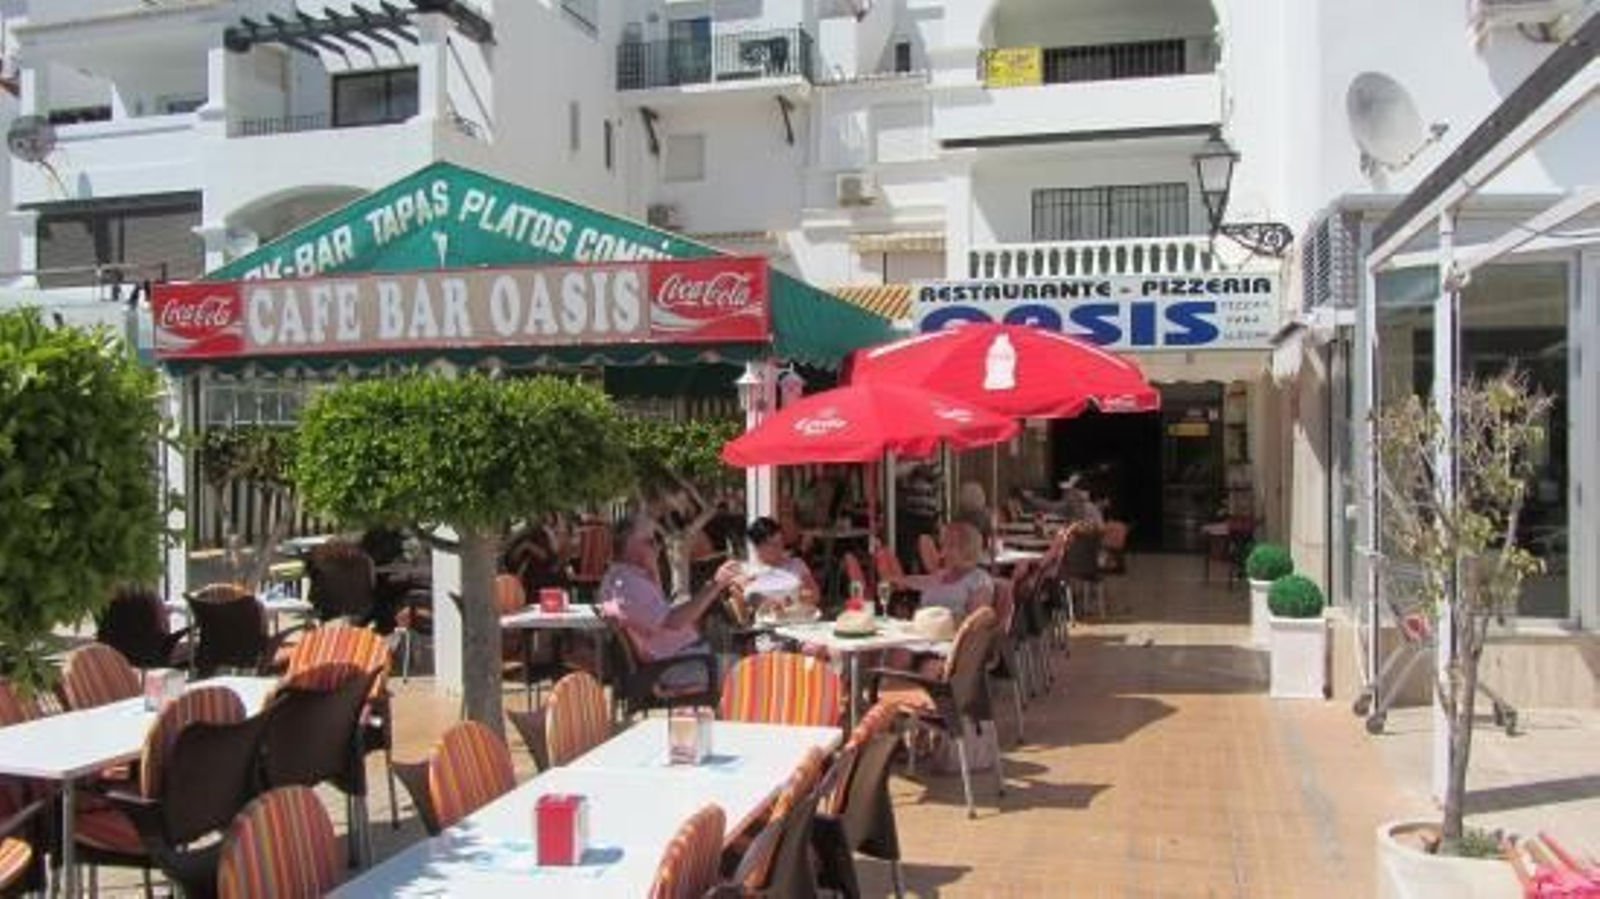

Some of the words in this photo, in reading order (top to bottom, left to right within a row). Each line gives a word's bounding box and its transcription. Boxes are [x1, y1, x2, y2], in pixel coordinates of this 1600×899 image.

[367, 182, 448, 243] TAPAS
[459, 189, 572, 253] PLATOS
[250, 287, 360, 344] CAFE
[378, 277, 471, 338] BAR
[490, 271, 640, 335] OASIS
[658, 272, 750, 307] Coca-Cola
[920, 282, 1111, 302] RESTAURANTE
[1141, 276, 1272, 297] PIZZERIA
